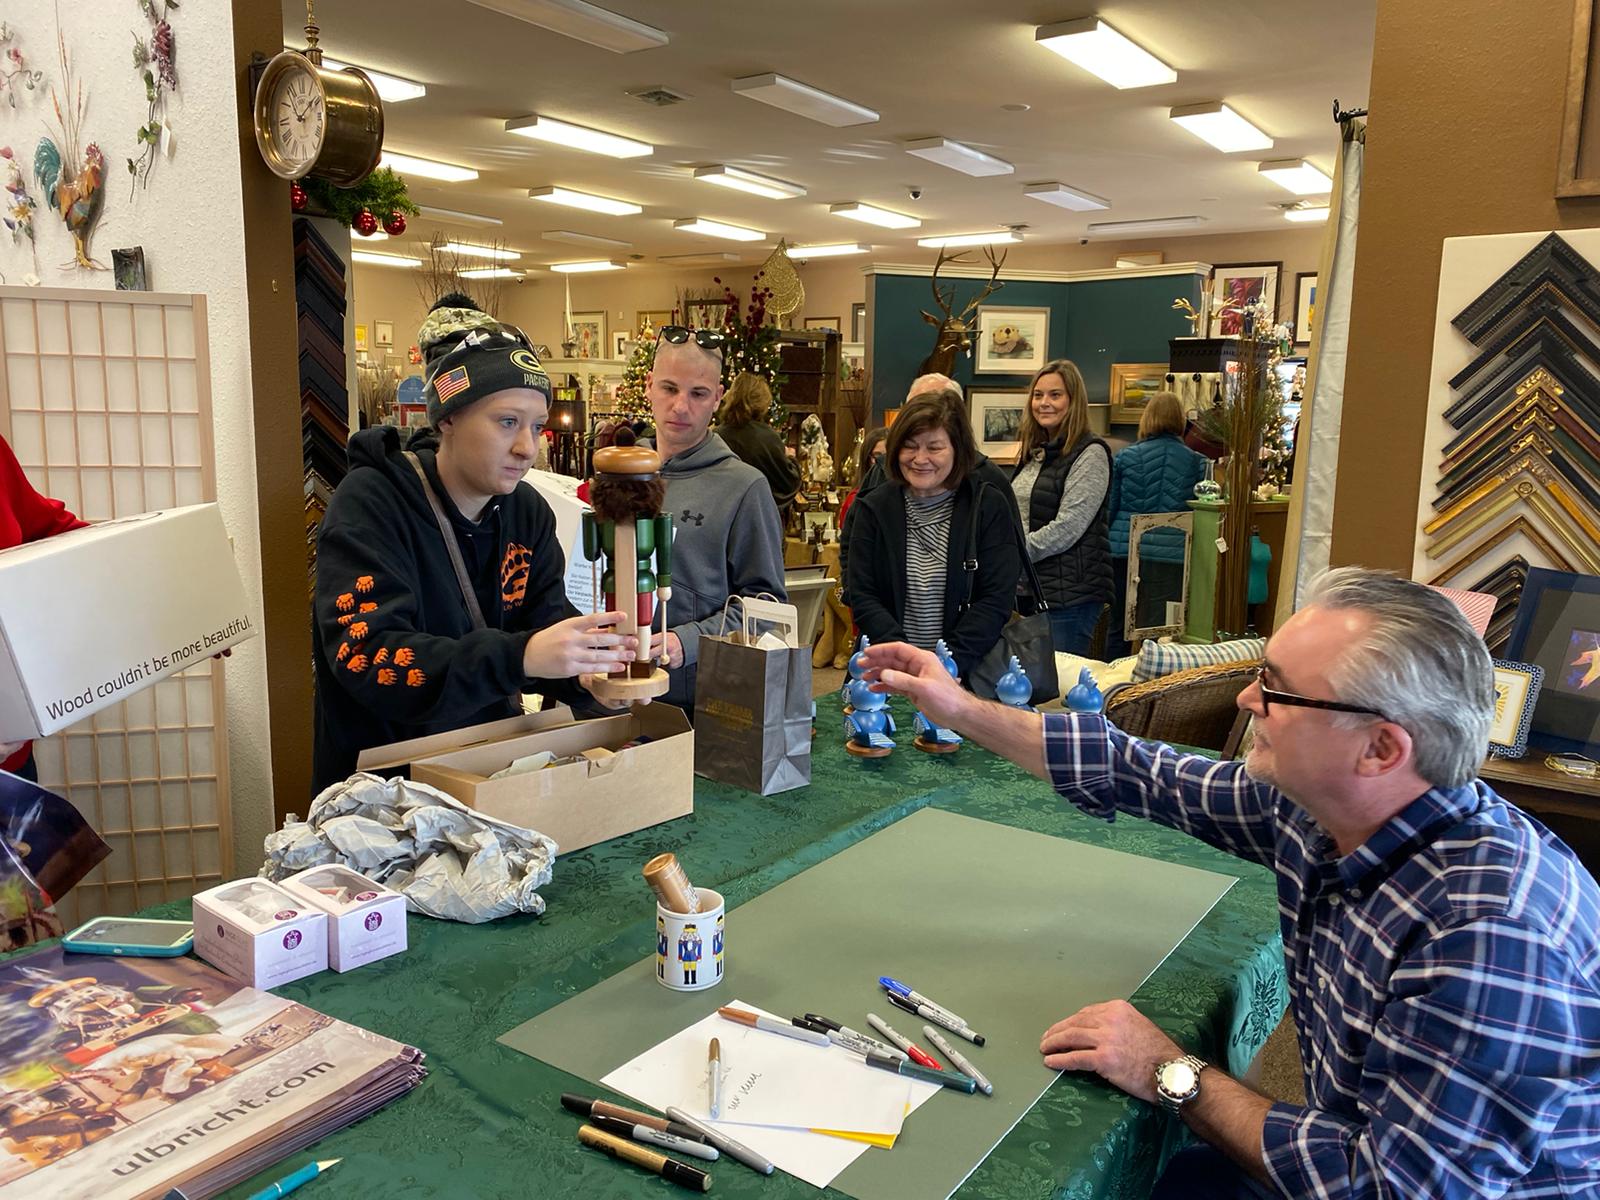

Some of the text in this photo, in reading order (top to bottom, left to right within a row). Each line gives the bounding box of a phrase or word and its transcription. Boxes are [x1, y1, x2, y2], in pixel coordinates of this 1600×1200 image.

[46, 615, 253, 720] Wood couldn't be more beautiful.
[112, 1061, 336, 1177] ulbricht.com
